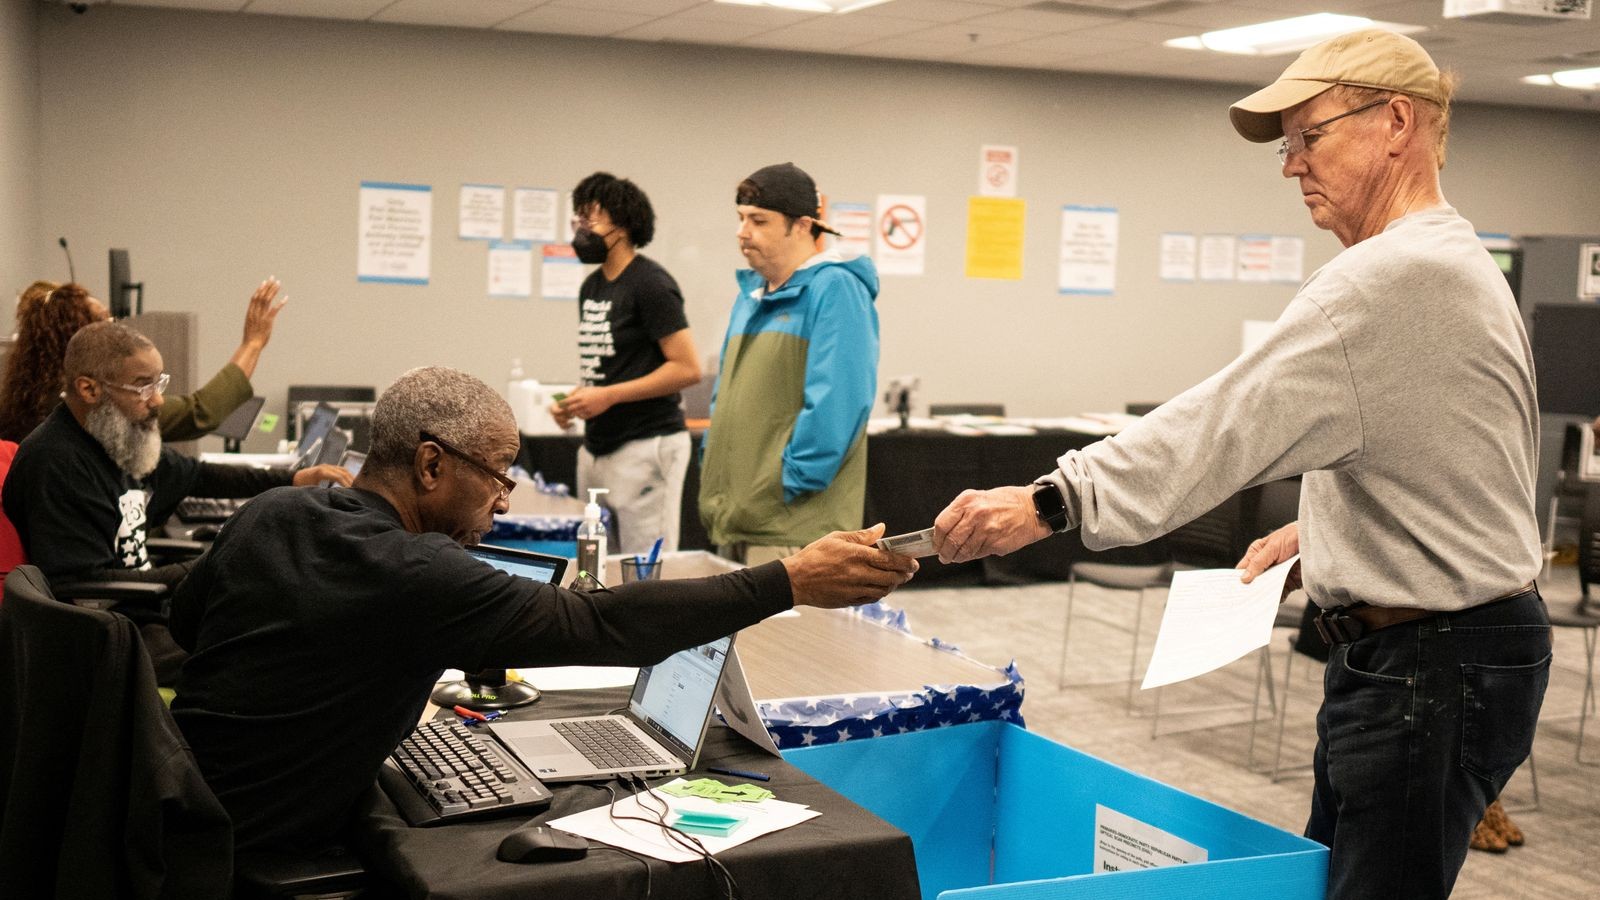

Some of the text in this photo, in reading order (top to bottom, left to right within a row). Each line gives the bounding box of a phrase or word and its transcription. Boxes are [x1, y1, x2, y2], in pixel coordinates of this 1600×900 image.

[1100, 830, 1113, 838] OPTICAL
[1139, 841, 1150, 849] PARTY
[1172, 855, 1183, 863] PARTY
[1103, 860, 1120, 872] Inst
